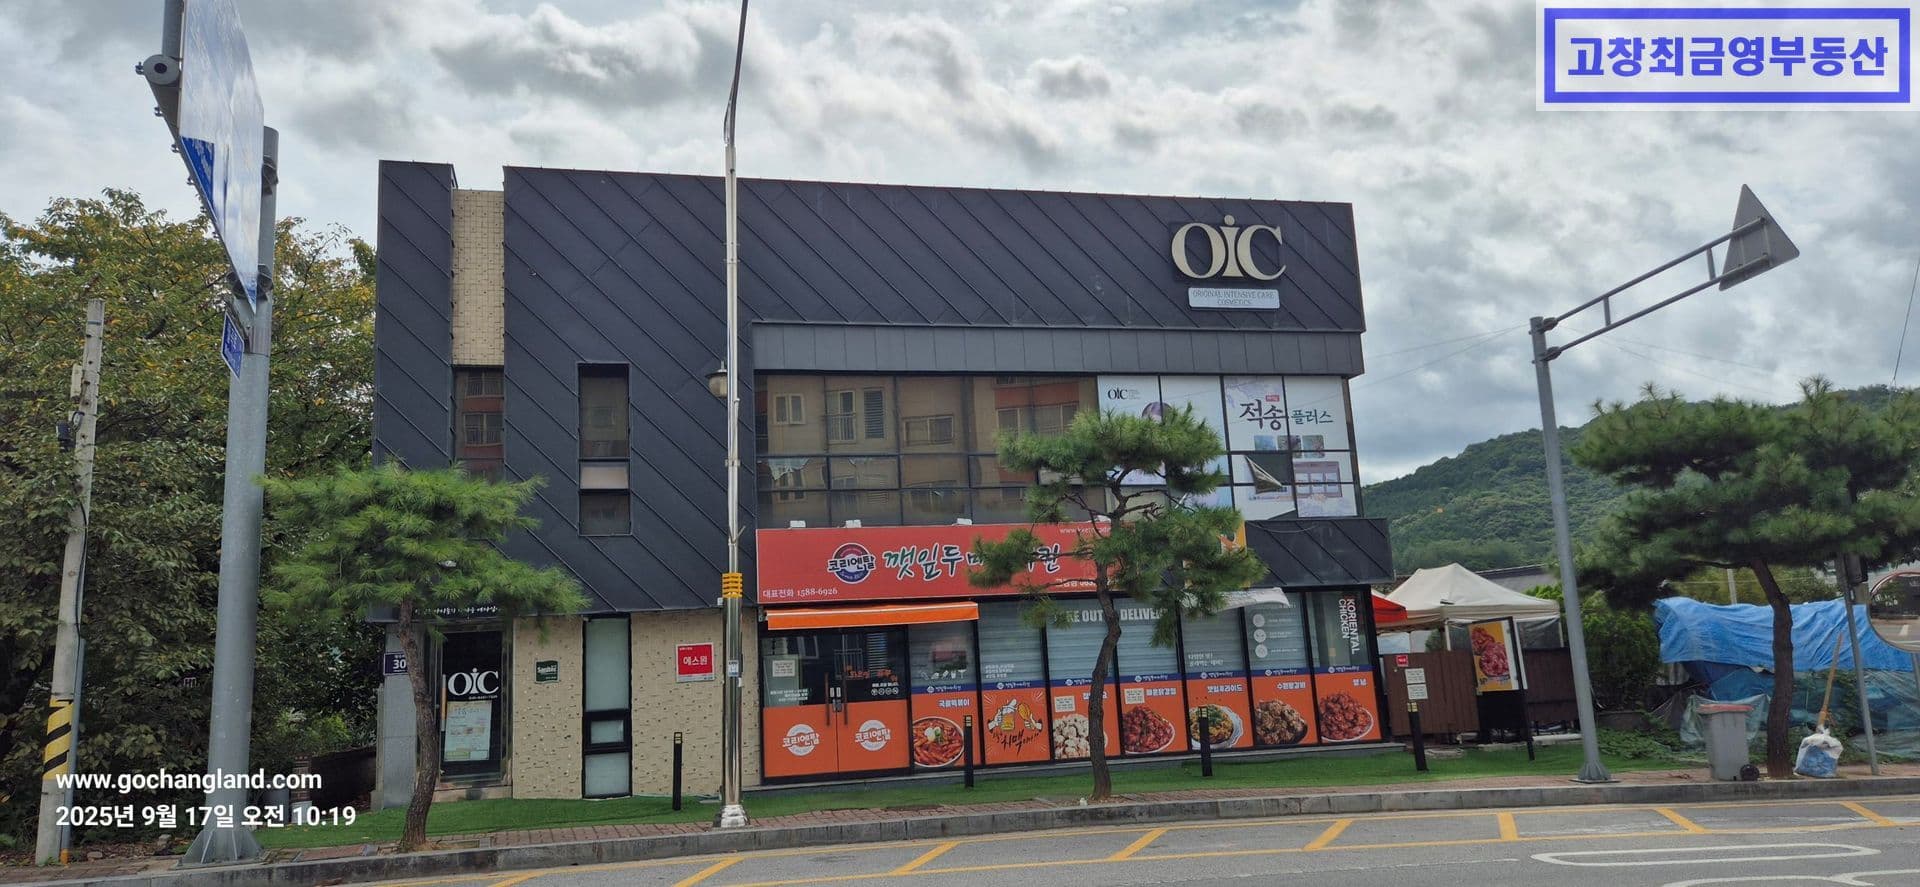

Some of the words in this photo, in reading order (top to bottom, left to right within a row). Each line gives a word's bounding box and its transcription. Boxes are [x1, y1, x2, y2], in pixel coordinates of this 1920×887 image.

[1239, 399, 1290, 431] 적송
[1291, 408, 1334, 425] 플러스
[762, 589, 794, 598] 대표전화
[797, 587, 838, 598] 1588-6926
[1338, 598, 1350, 640] CHICKEN
[1346, 598, 1361, 655] KORIENTAL
[392, 658, 407, 669] 30
